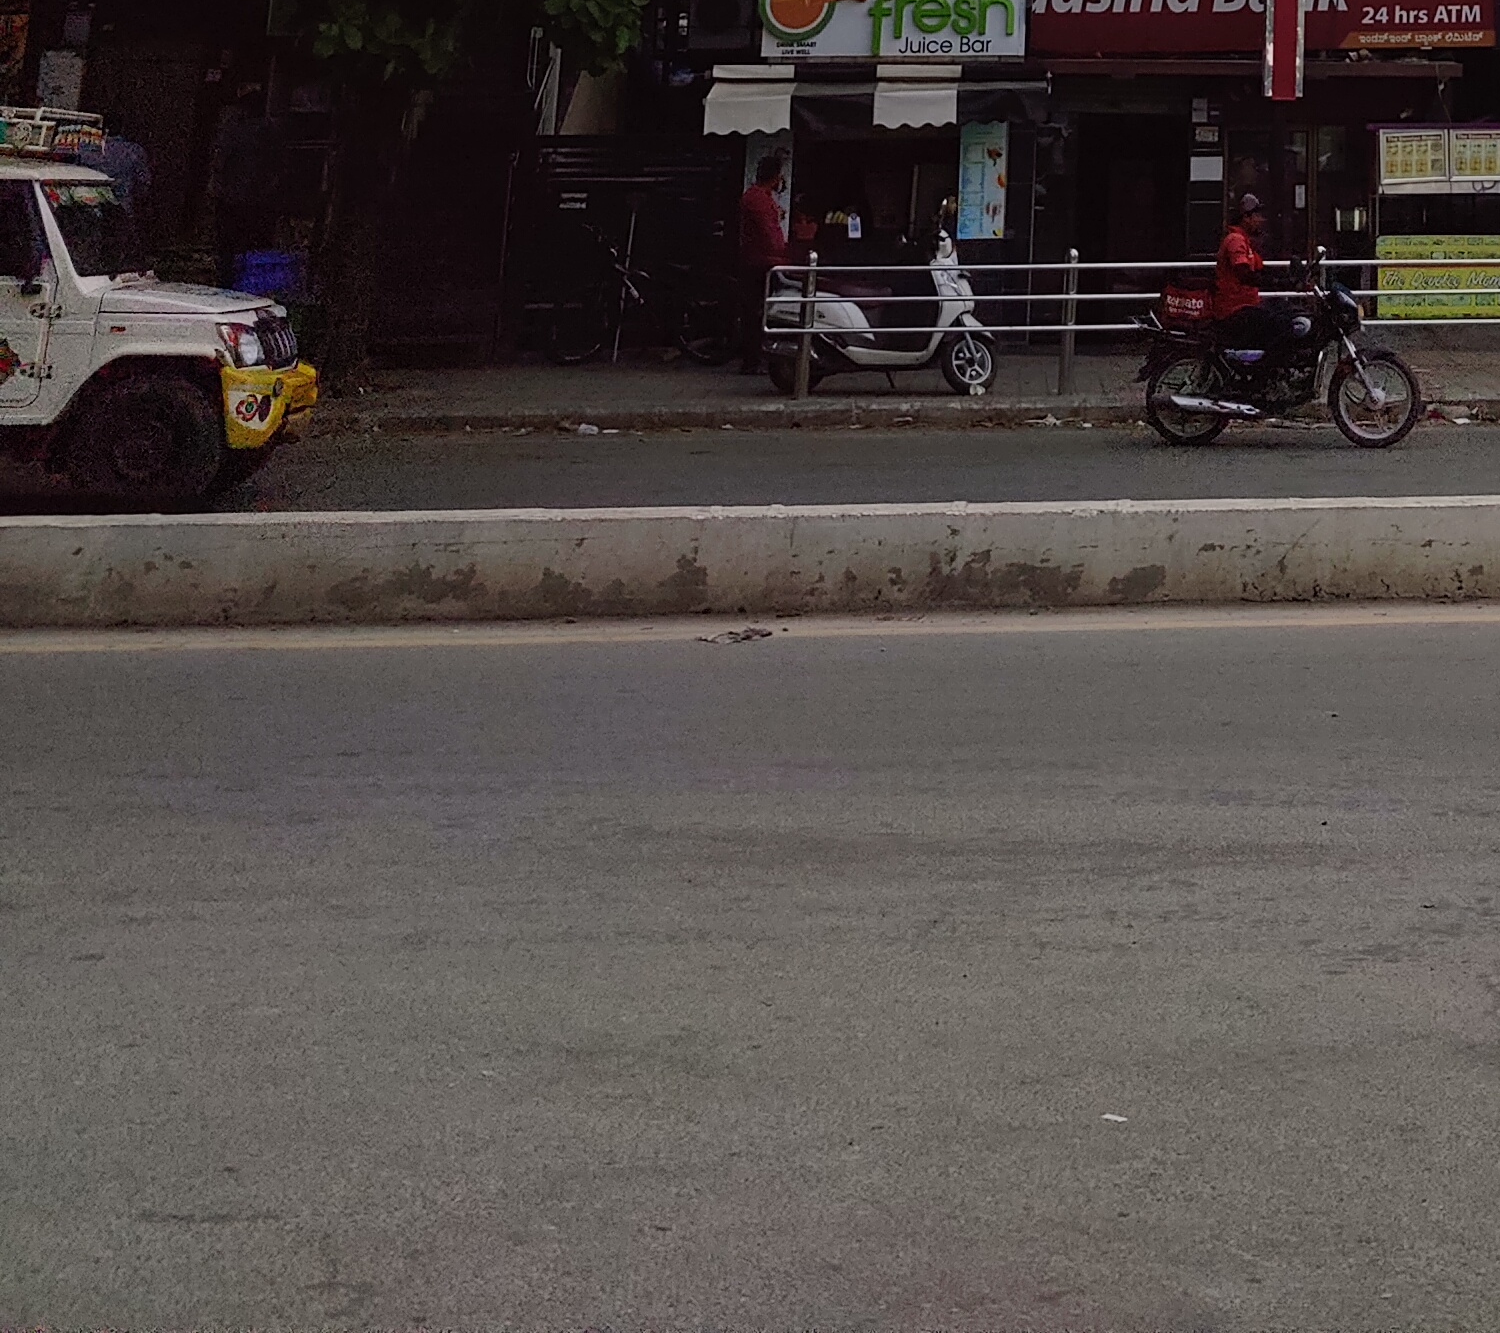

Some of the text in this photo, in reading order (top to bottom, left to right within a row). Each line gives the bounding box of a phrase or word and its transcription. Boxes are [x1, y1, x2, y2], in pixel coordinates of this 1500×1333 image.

[1361, 5, 1481, 24] 24 hrs ATM
[899, 36, 992, 54] Juice Bar
